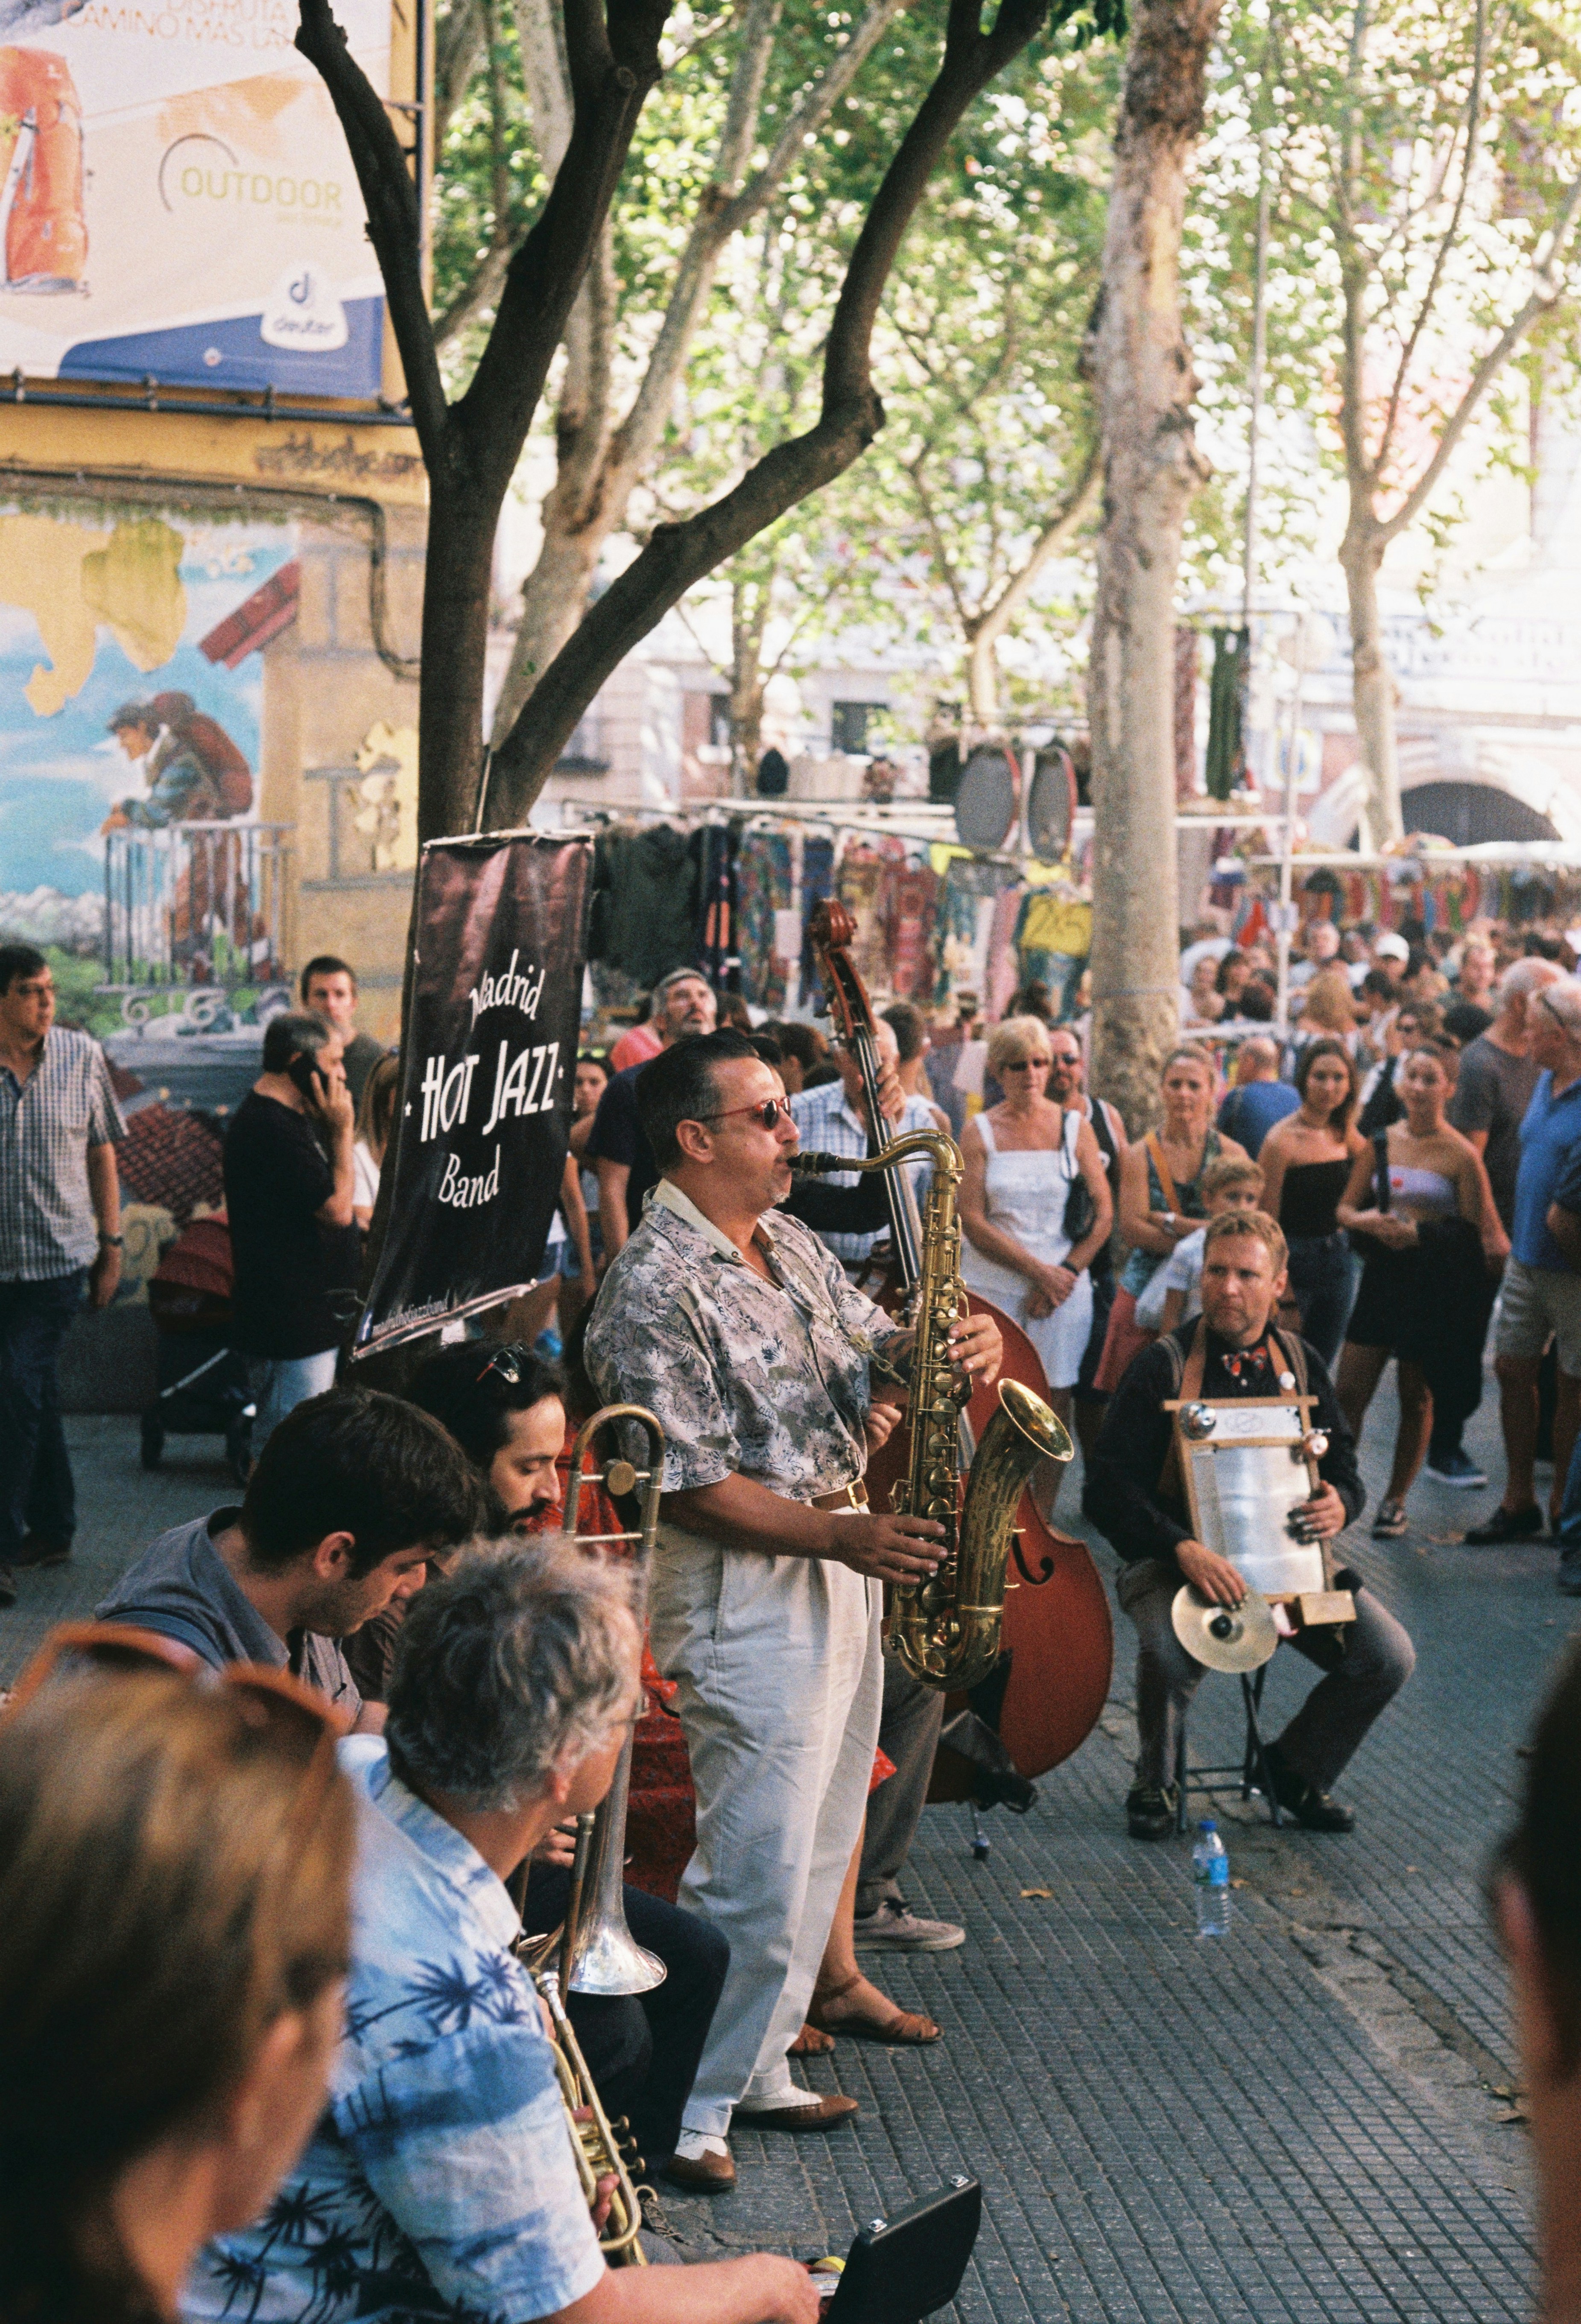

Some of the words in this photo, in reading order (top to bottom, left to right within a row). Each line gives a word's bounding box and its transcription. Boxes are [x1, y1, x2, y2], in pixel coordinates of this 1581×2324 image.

[181, 166, 342, 210] OUTDOOR
[469, 948, 545, 1032] Madrid
[421, 1054, 480, 1142] HOT
[482, 1040, 559, 1136] JAZZ
[438, 1144, 500, 1209] Band
